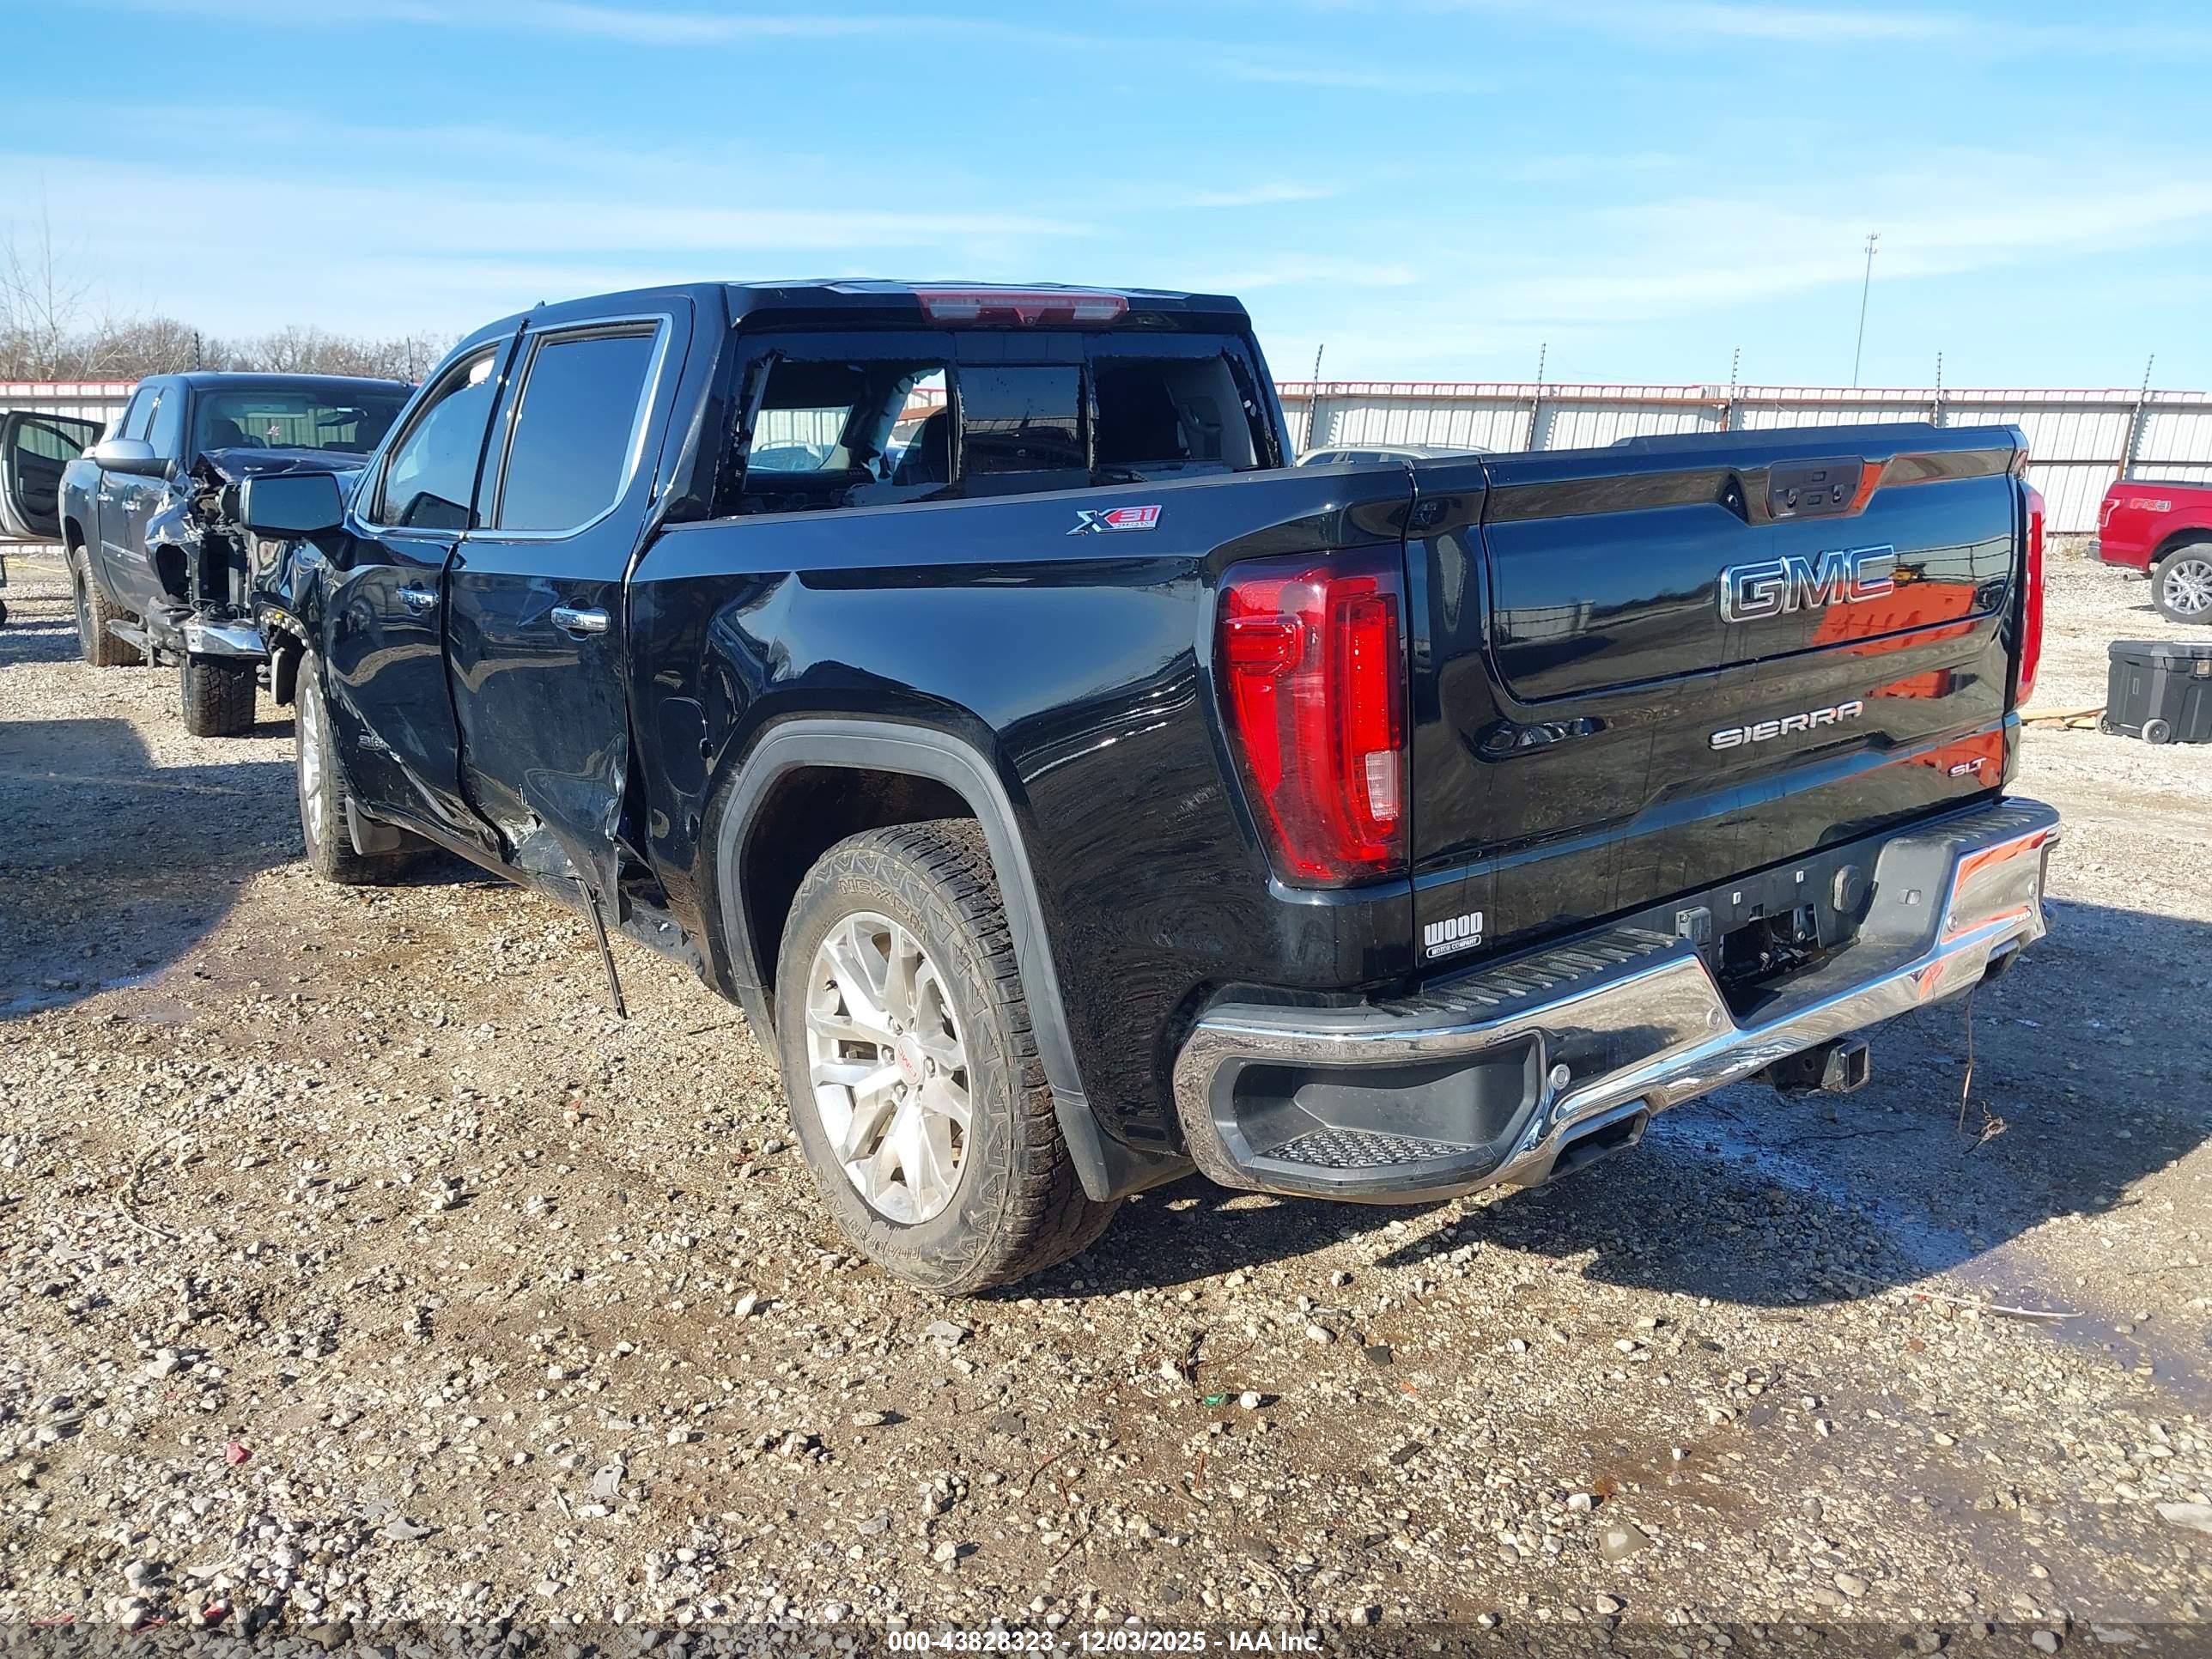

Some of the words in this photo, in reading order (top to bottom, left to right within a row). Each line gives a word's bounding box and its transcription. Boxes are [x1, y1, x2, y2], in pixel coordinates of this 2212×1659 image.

[2130, 498, 2172, 512] FX4
[1720, 544, 1895, 624] GMC
[1708, 699, 1865, 750] SIERRA
[1948, 757, 1987, 777] SLT
[1424, 911, 1483, 946] WOOD
[1431, 945, 1451, 956] MOTOR
